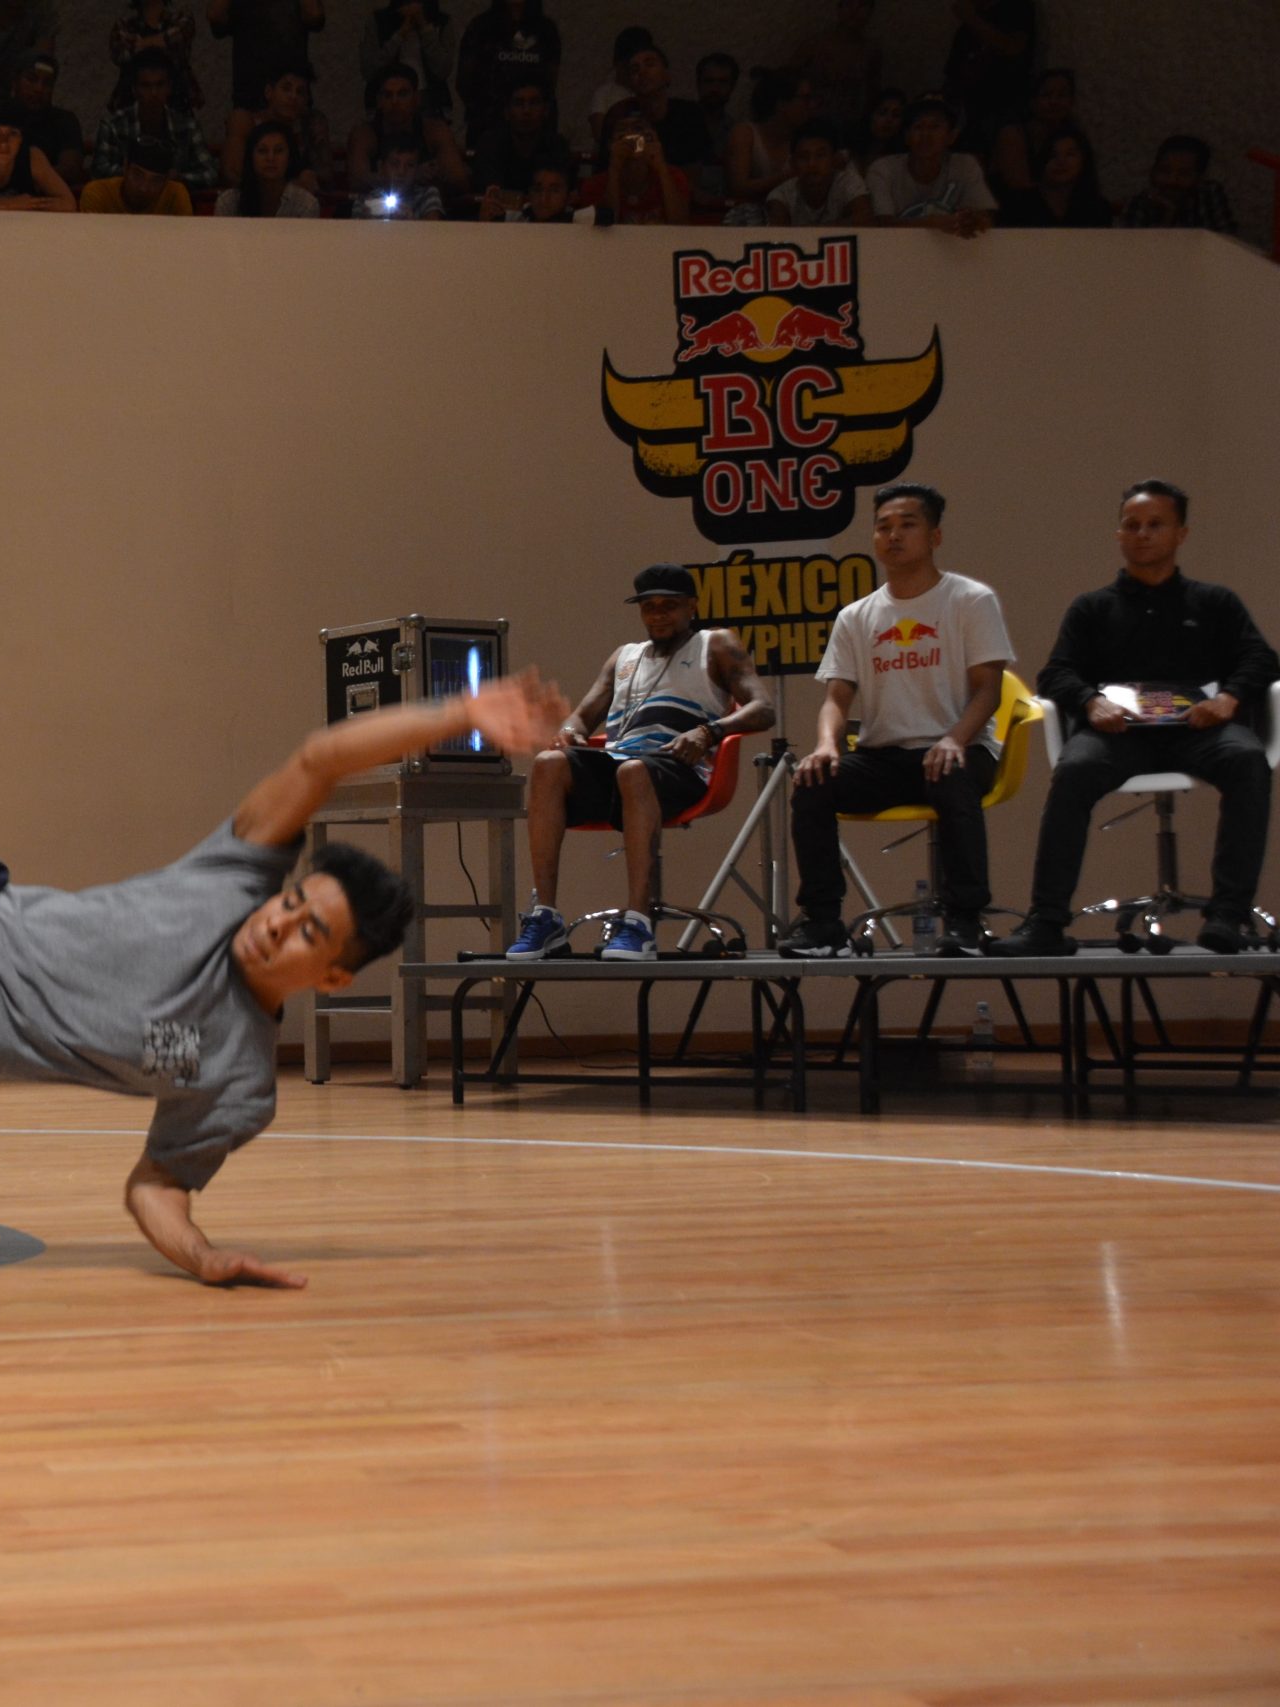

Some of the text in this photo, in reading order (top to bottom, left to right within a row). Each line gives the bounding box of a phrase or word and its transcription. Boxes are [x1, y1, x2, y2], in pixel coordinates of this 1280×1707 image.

[700, 365, 837, 452] BC
[703, 454, 841, 516] ONE
[731, 620, 833, 666] YPHE
